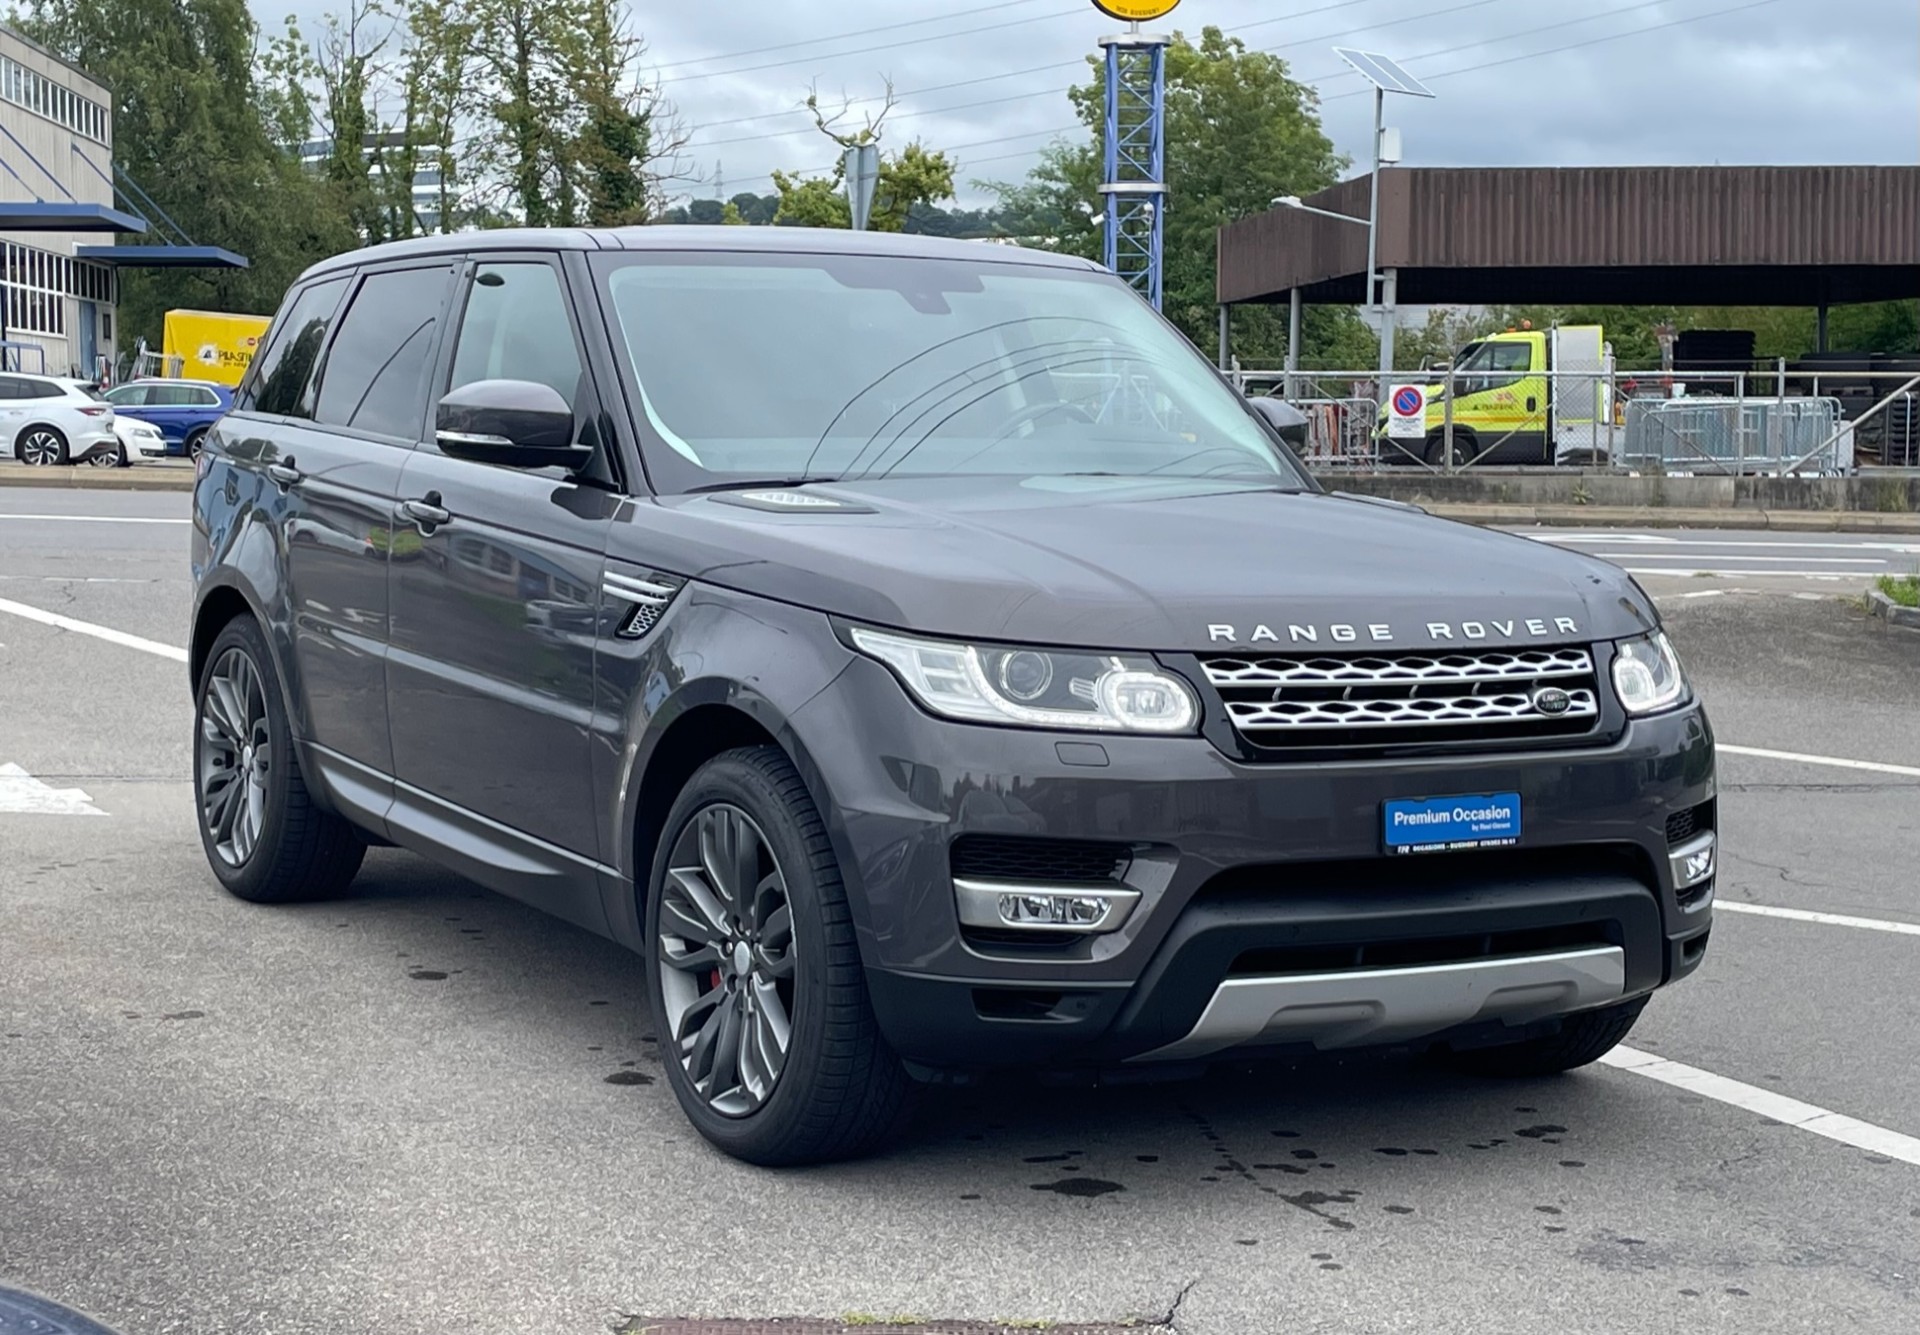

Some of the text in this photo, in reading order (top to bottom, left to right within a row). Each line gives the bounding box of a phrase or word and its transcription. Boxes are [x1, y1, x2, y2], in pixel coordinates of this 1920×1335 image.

[1207, 616, 1578, 642] RANGE ROVER
[1394, 804, 1511, 826] Premium Occasion
